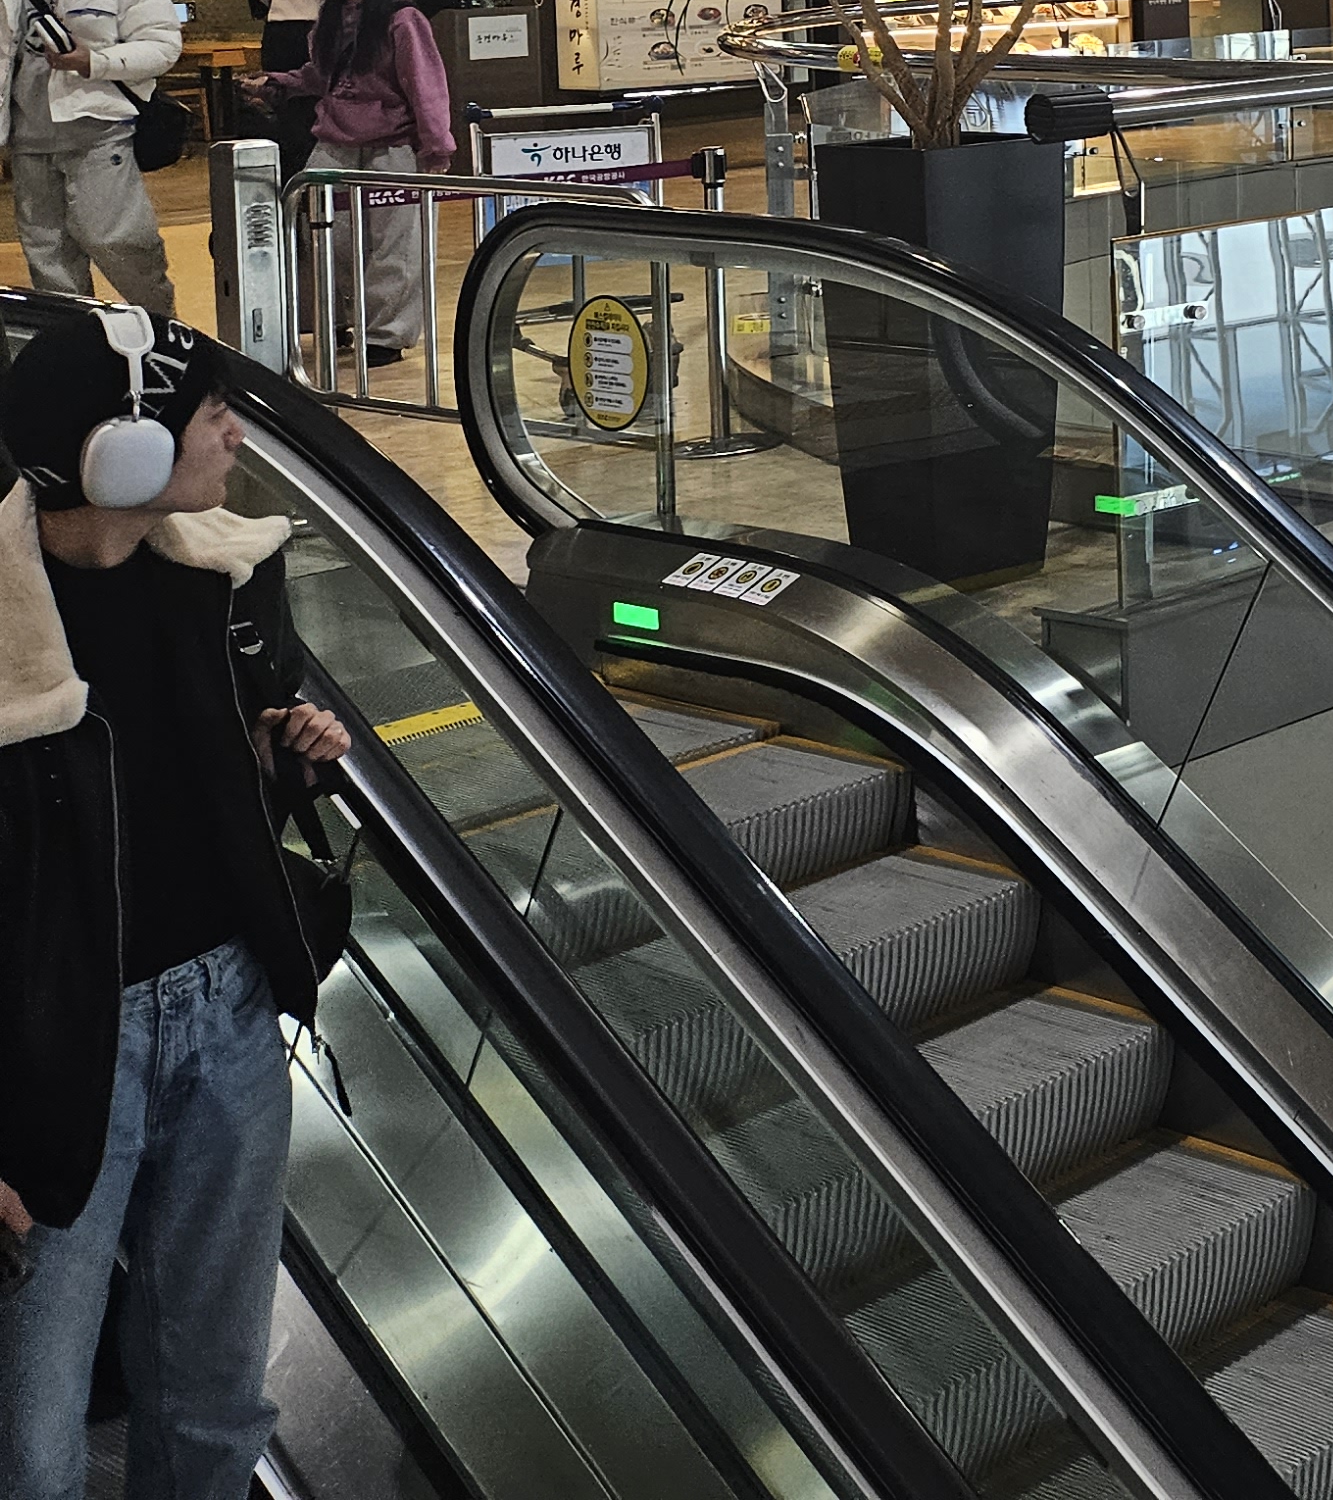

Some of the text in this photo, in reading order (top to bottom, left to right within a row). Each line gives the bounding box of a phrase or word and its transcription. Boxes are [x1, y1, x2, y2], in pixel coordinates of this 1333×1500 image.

[552, 142, 621, 163] 하나은행
[582, 172, 625, 183] 한국공항공사
[369, 189, 405, 206] KAC
